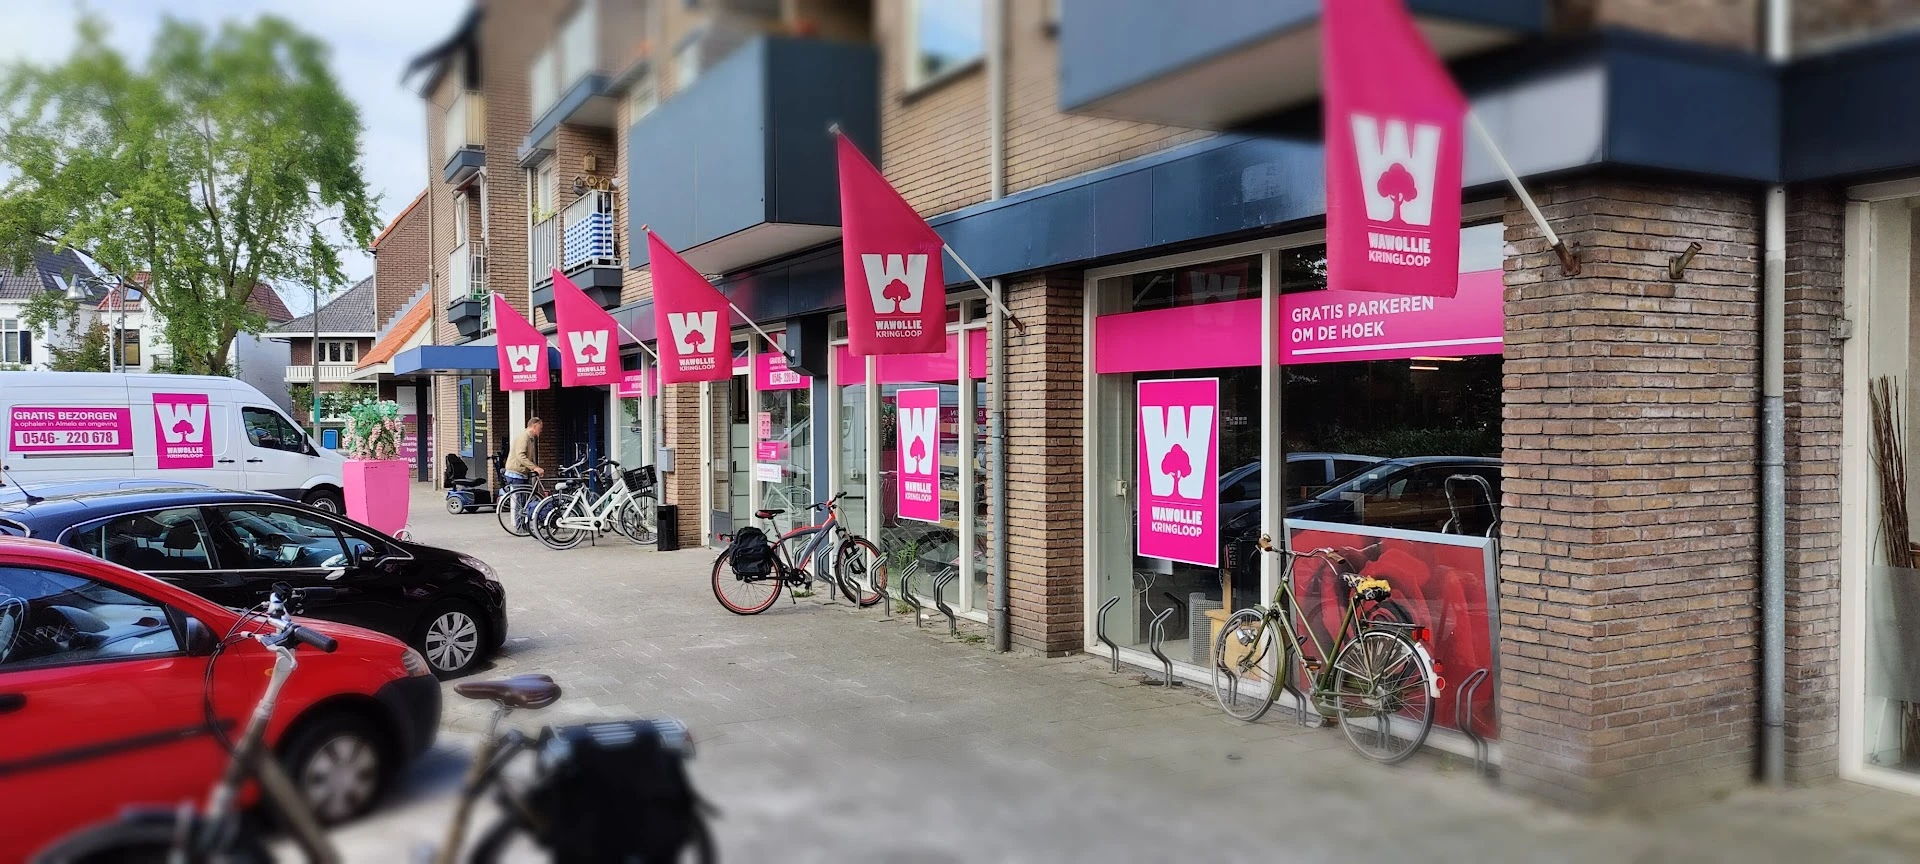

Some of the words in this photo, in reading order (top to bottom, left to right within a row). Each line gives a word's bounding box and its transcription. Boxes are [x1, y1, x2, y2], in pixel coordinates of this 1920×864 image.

[1368, 232, 1431, 254] WAWOLLIE
[1368, 251, 1431, 267] KRINGLOOP
[1292, 303, 1343, 323] GRATIS
[1348, 295, 1434, 318] PARKEREN
[875, 320, 922, 330] WAWOLLIE
[876, 329, 922, 338] KRINGLOOP
[1291, 326, 1314, 343] OM
[1317, 325, 1337, 340] DE
[1342, 320, 1385, 339] HOEK
[679, 357, 715, 366] WAWOLLIE
[679, 364, 715, 372] KRINGLOOP
[14, 411, 55, 420] GRATIS
[58, 411, 117, 420] BEZORGEN
[22, 432, 60, 444] 0546-
[66, 432, 89, 444] 220
[92, 431, 113, 443] 678
[904, 481, 932, 493] WAWOLLIE
[905, 492, 932, 502] KRINGLOOP
[1152, 506, 1203, 525] WAWOLLIE
[1152, 522, 1203, 537] KRINGLOOP
